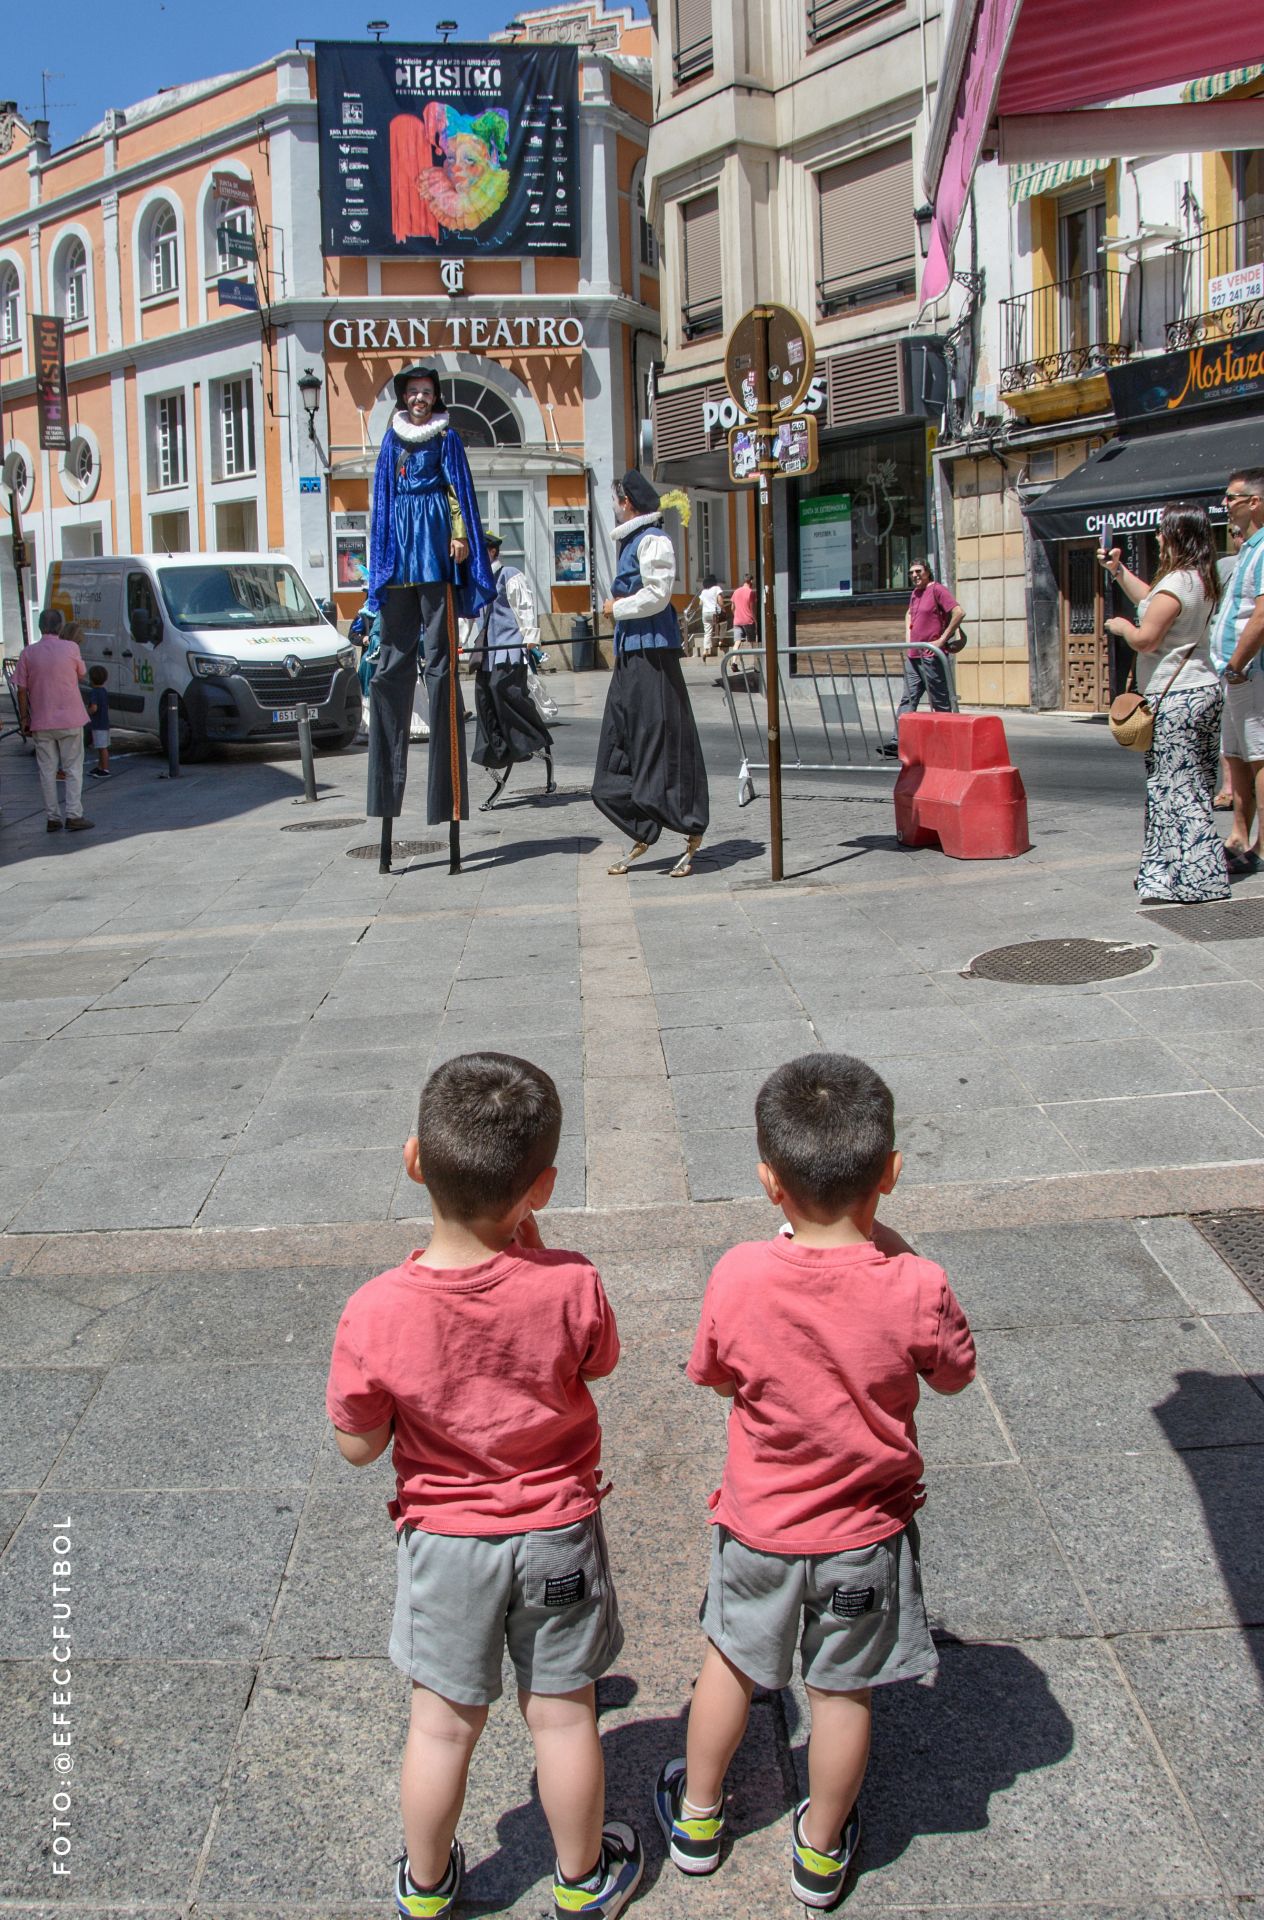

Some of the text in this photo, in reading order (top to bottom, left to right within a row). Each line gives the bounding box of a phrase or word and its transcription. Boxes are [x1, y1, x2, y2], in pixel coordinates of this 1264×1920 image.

[1211, 268, 1261, 293] SE VENDE
[1212, 283, 1261, 307] 927 241 748
[328, 317, 584, 348] GRAN TEATRO
[133, 656, 153, 684] bida
